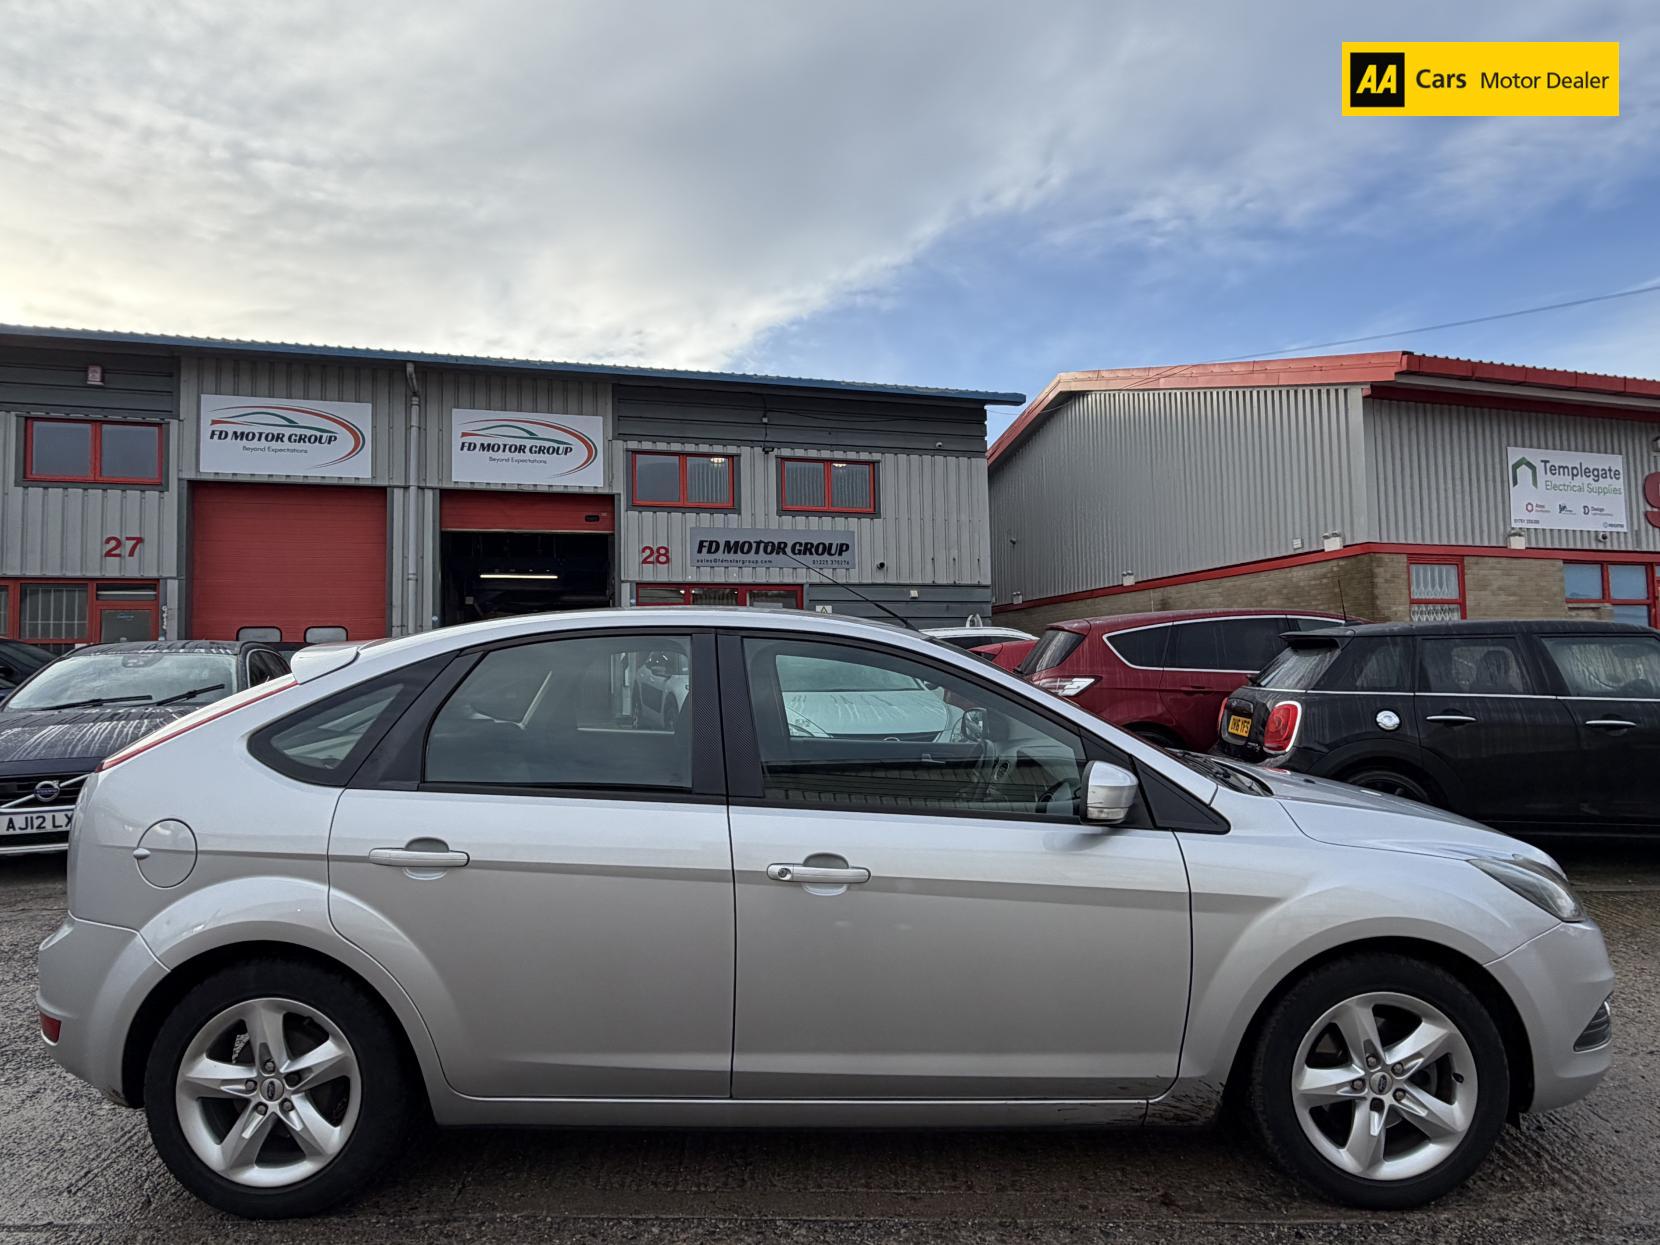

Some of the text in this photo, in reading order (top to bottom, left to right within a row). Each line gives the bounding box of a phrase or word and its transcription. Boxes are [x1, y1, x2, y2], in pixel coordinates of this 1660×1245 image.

[209, 429, 338, 446] FD MOTOR GROUP
[242, 446, 309, 455] Beyond Expectations
[460, 441, 573, 457] FD MOTOR GROUP
[488, 456, 548, 465] Beyond Expectations
[1541, 459, 1621, 483] Templegate
[1545, 480, 1622, 497] Electrical Supplies
[103, 536, 144, 558] 27
[641, 545, 670, 565] 28
[697, 539, 850, 557] FD MOTOR GROUP
